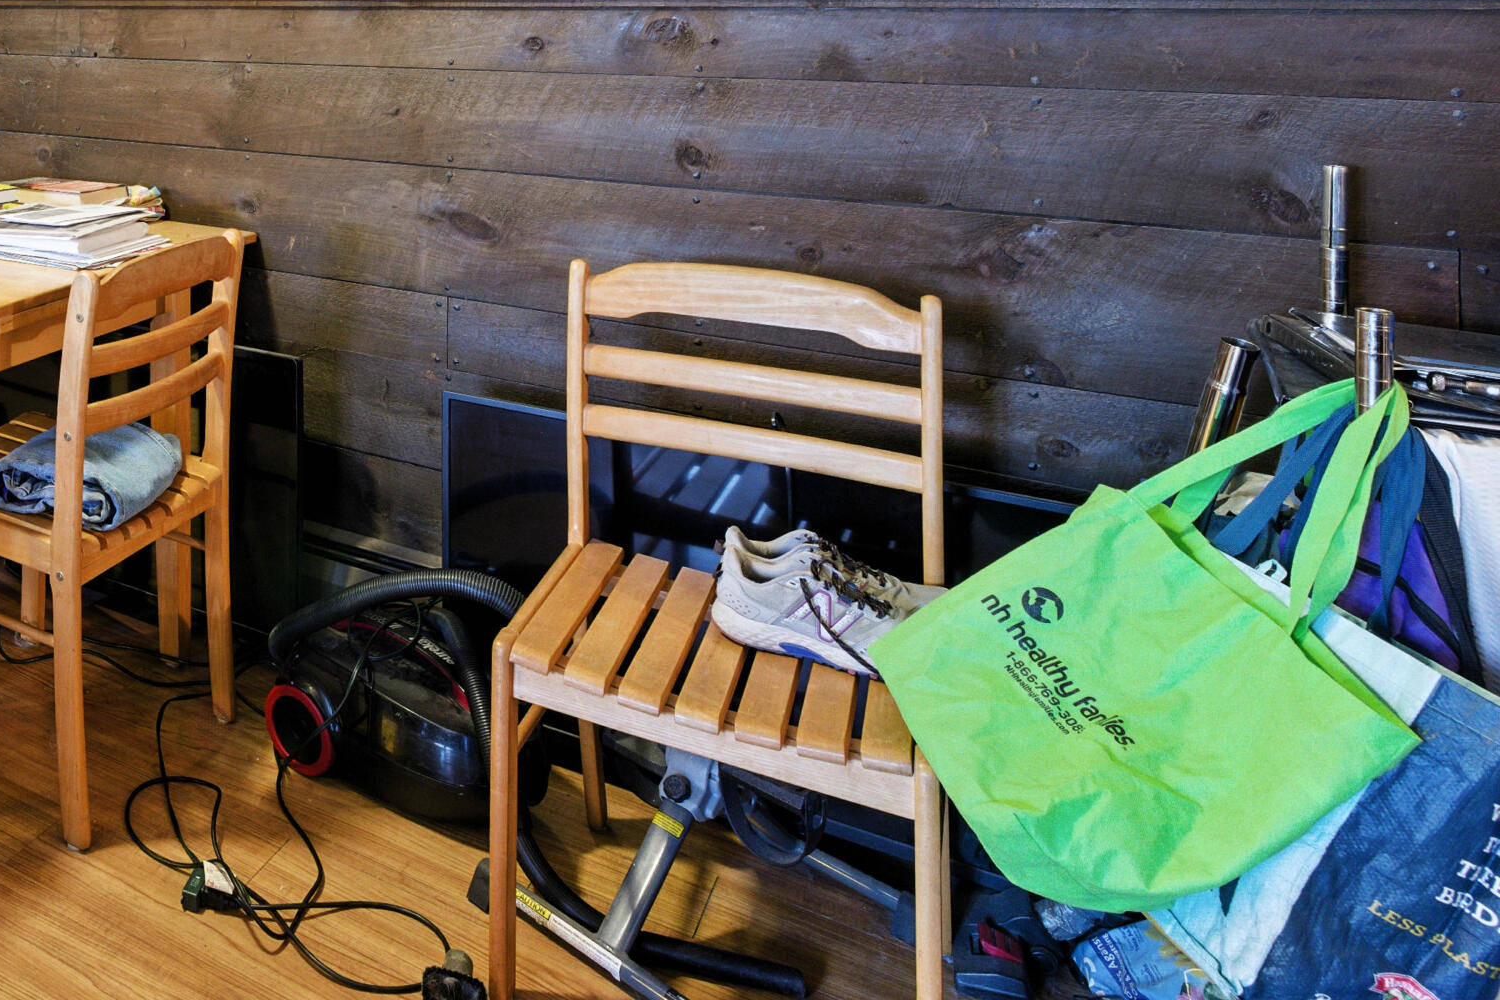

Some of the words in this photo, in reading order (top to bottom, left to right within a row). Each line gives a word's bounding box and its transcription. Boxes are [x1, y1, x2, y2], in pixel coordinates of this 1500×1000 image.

[980, 594, 1011, 624] nh
[1005, 620, 1081, 699] healthy
[1366, 899, 1428, 938] LESS
[1435, 886, 1500, 935] BIRD
